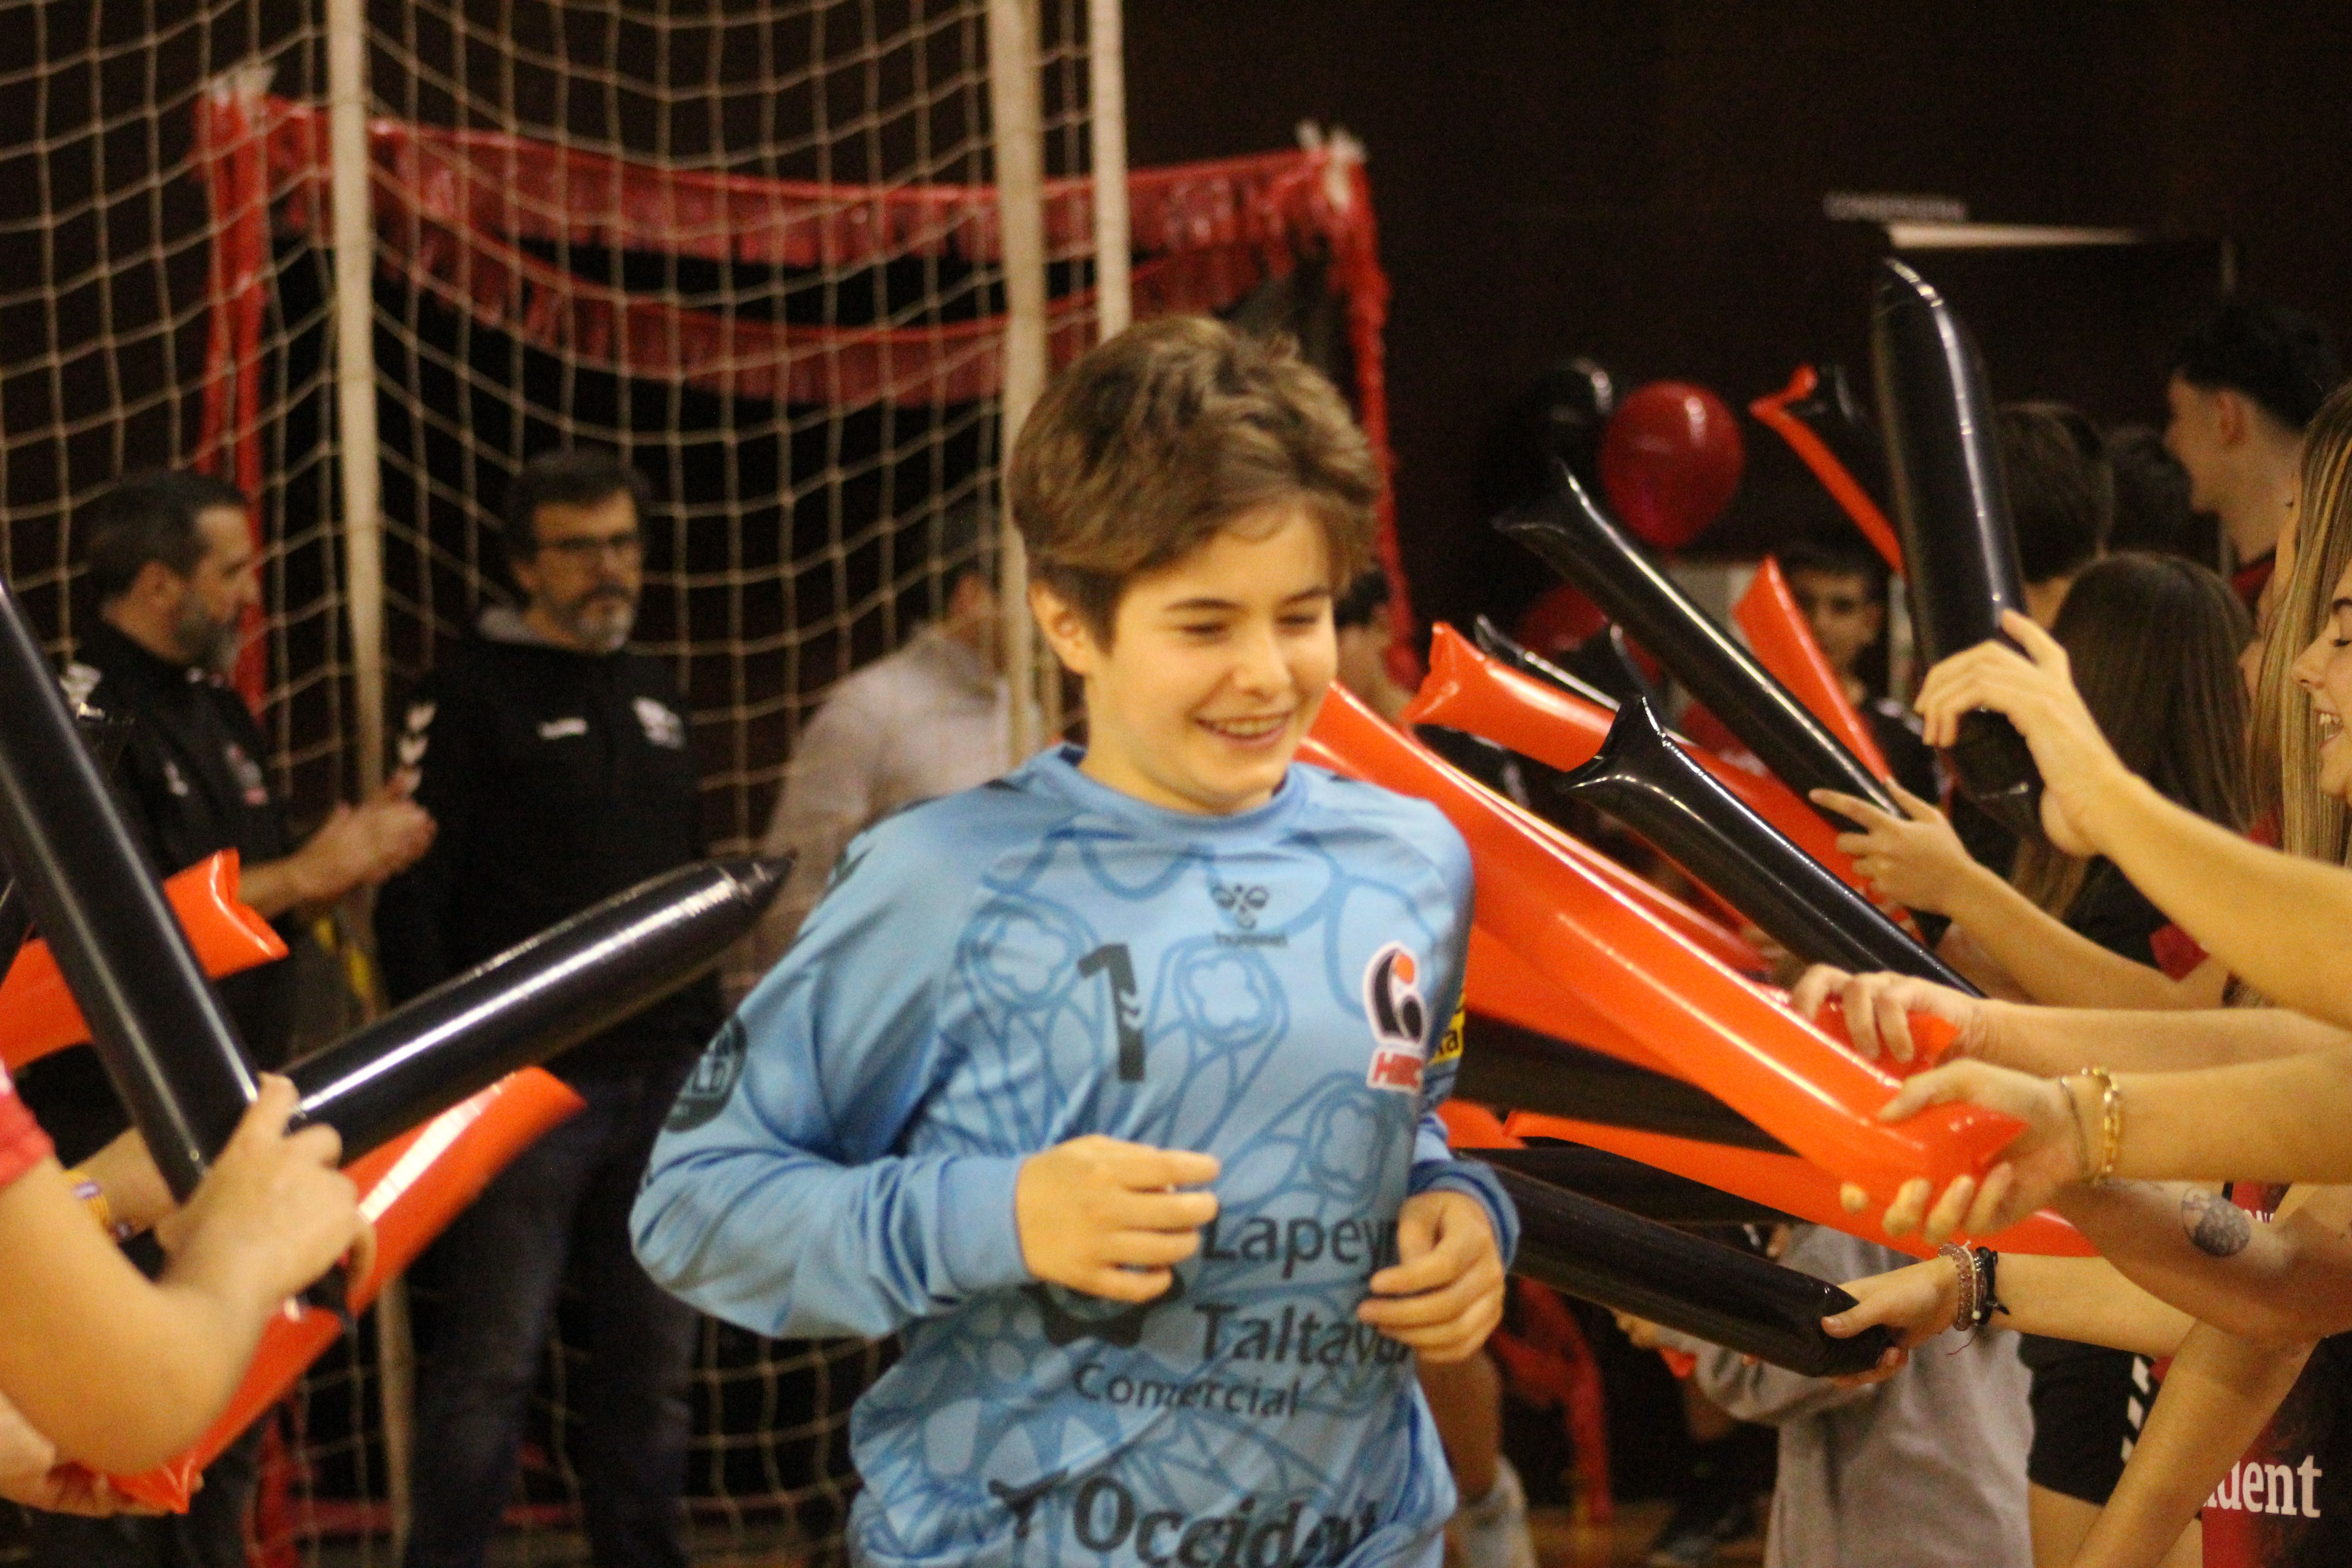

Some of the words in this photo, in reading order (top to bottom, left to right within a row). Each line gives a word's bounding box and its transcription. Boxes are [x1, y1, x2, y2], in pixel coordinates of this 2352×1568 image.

[1077, 943, 1146, 1081] 1
[1072, 1361, 1301, 1418] Comercial
[2203, 1455, 2323, 1518] dent
